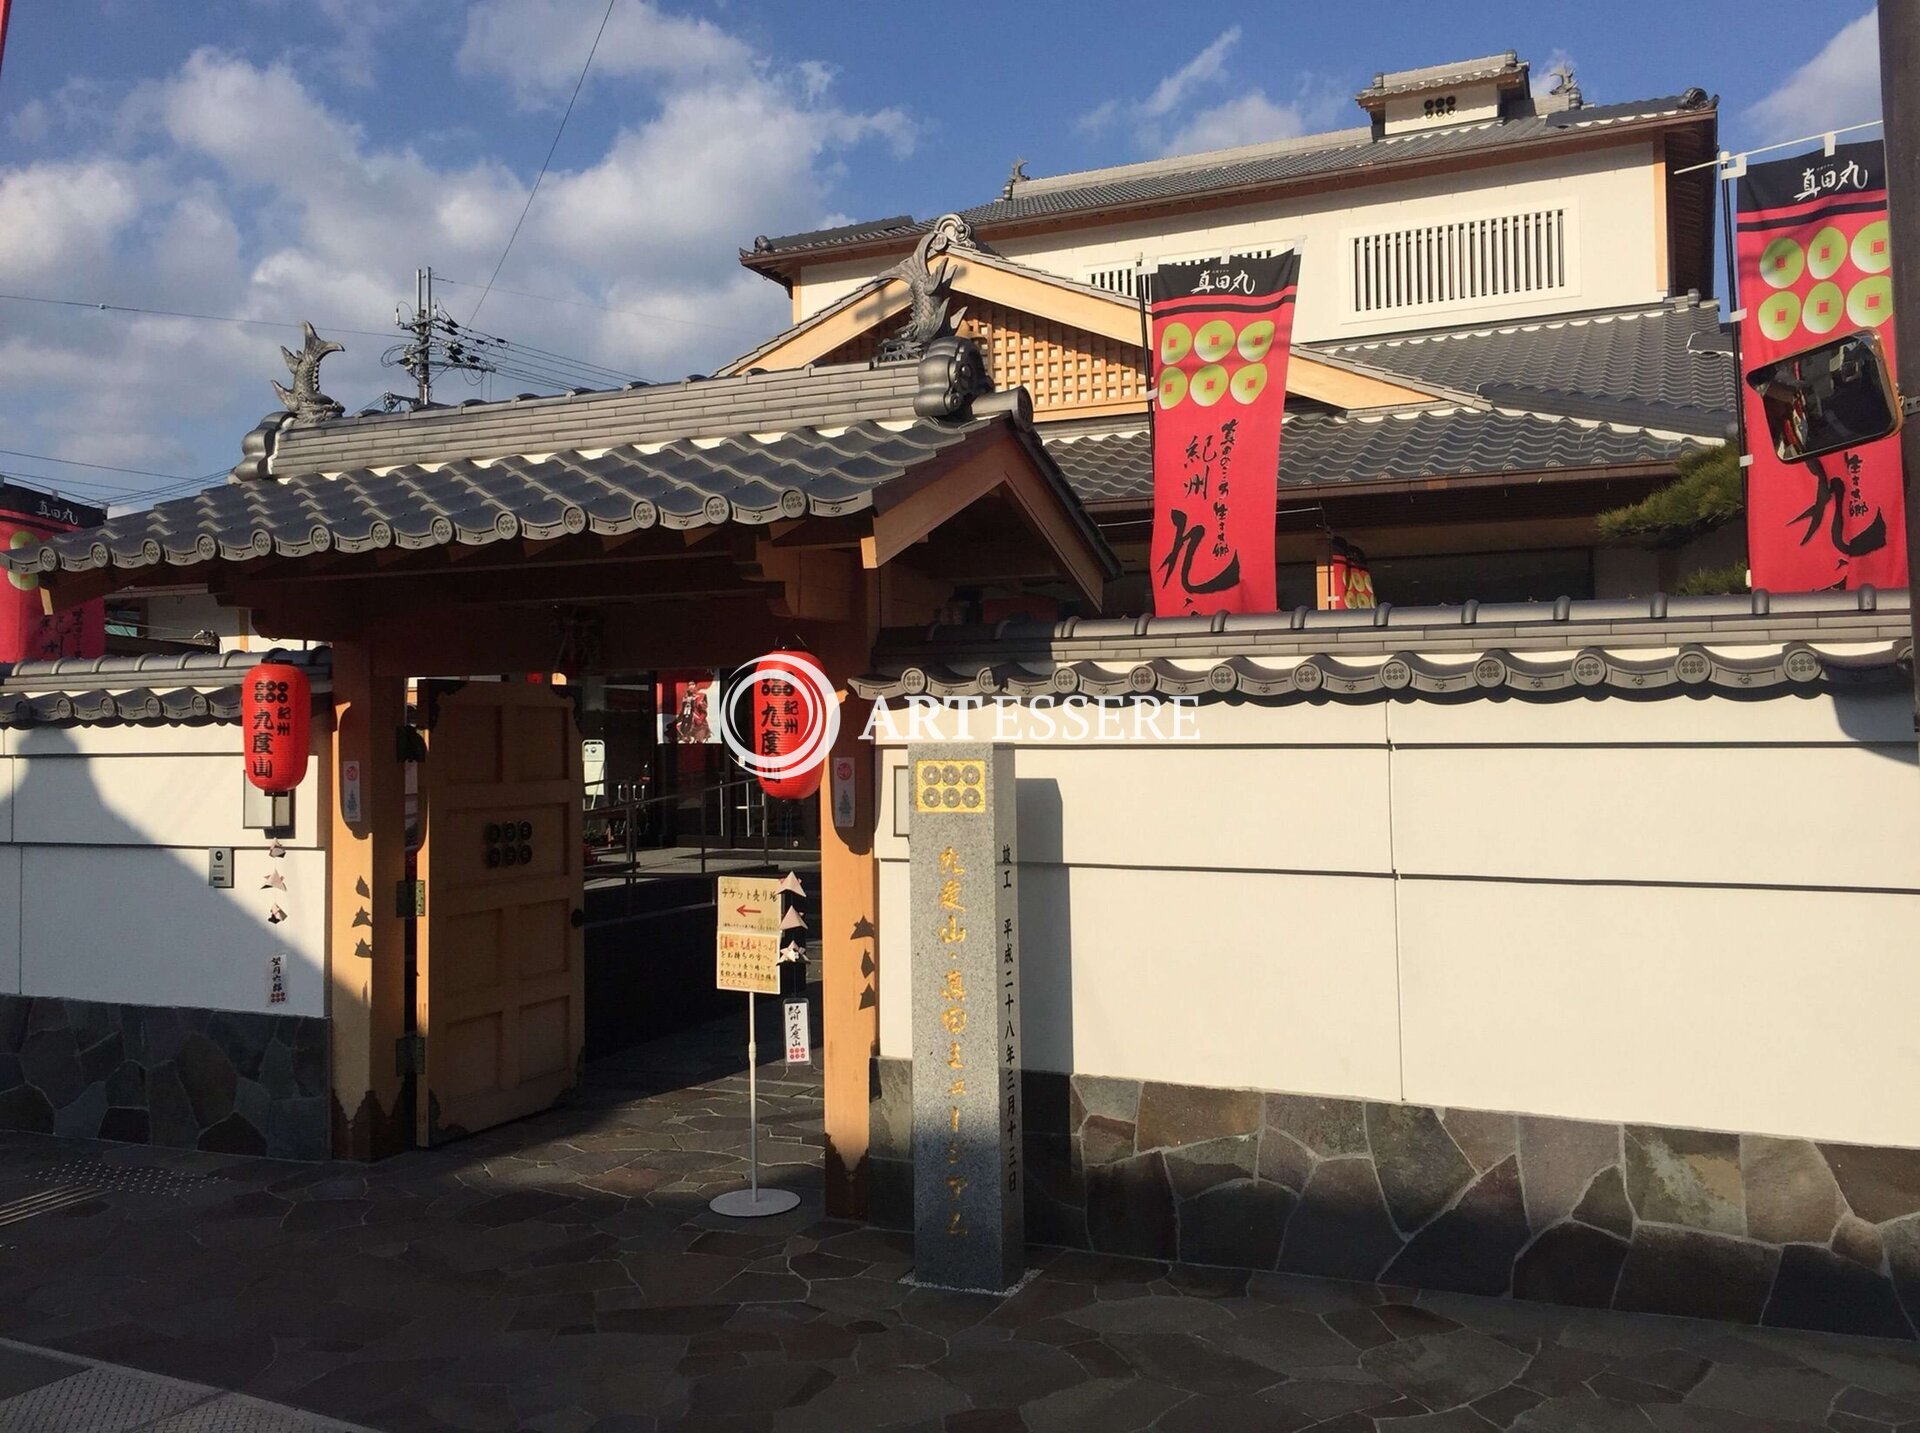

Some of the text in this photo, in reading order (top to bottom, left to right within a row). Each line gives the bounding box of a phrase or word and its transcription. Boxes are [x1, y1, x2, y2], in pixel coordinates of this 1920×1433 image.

[1793, 160, 1869, 202] 真田丸
[1190, 269, 1256, 295] 真田丸
[35, 500, 78, 526] 真田丸
[277, 705, 291, 737] 紀州
[783, 700, 799, 735] 紀州
[252, 706, 275, 779] 九度山
[761, 701, 781, 784] 九度山
[790, 1023, 801, 1048] 九度山
